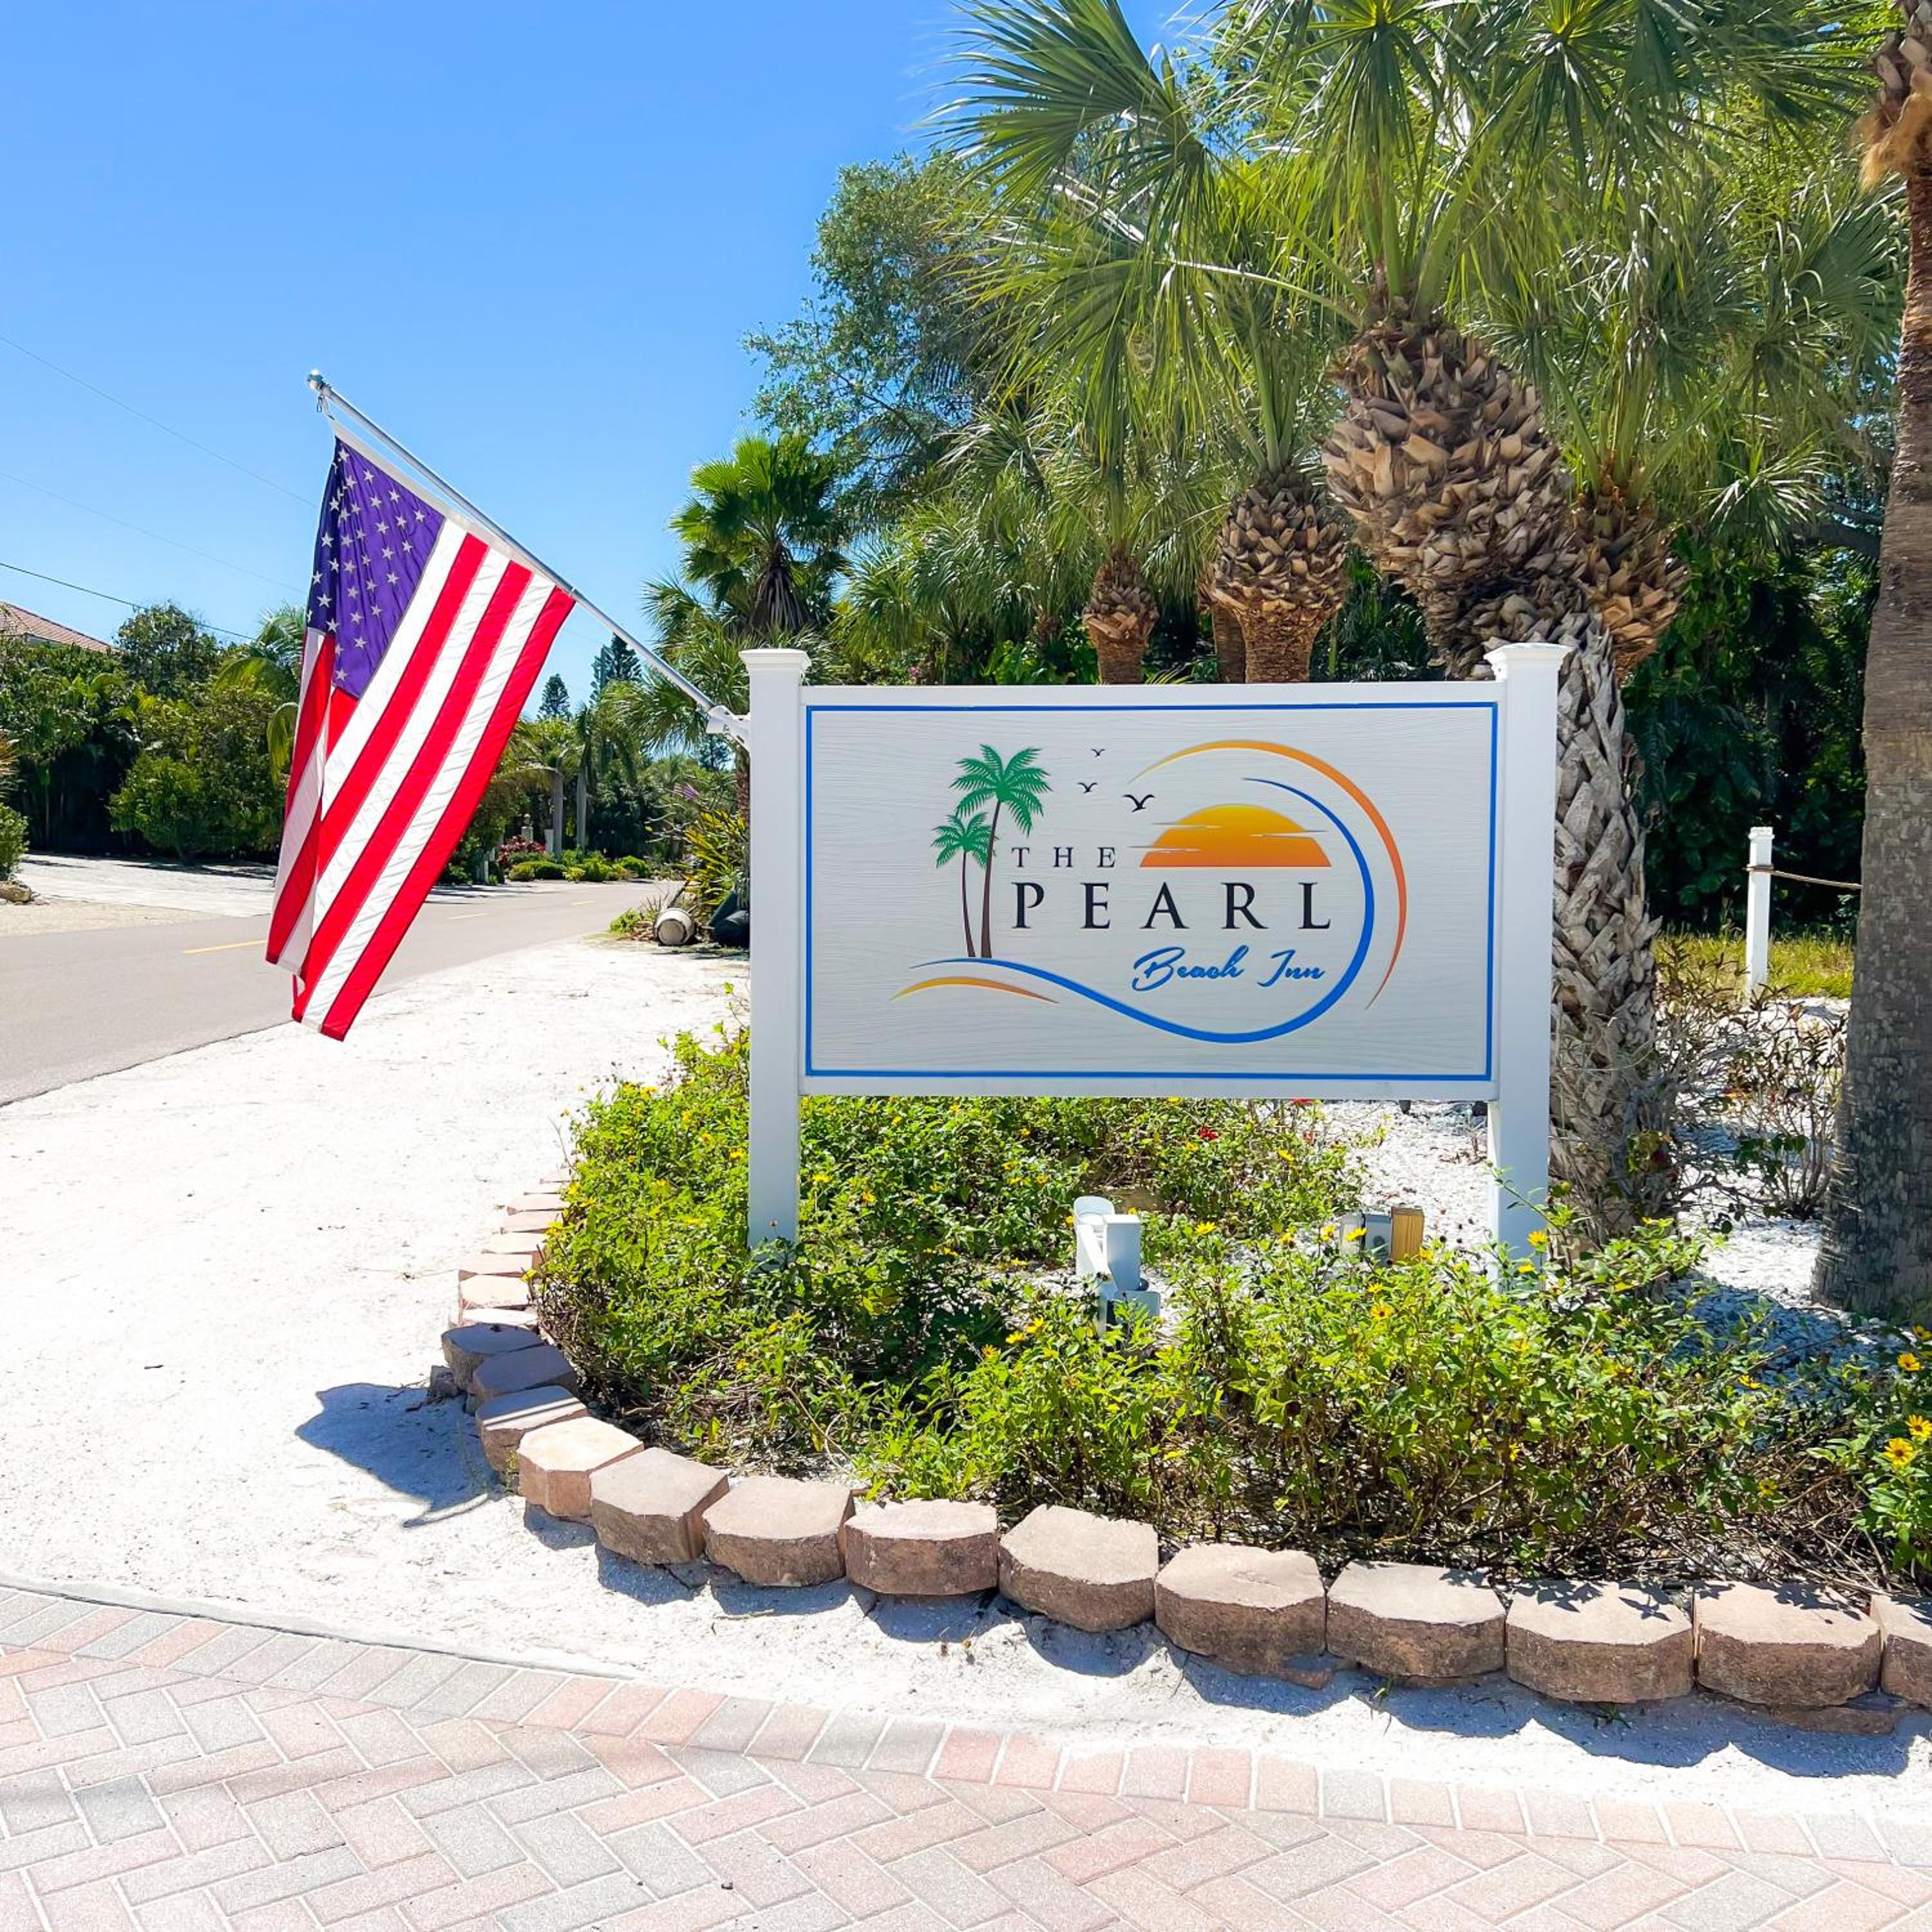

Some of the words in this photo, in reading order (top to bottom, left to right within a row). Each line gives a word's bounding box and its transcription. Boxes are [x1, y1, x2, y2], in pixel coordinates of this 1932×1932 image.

[1011, 846, 1116, 869] THE
[1010, 881, 1331, 930] PEARL
[1131, 944, 1250, 992] Beach
[1256, 949, 1326, 989] Inn
